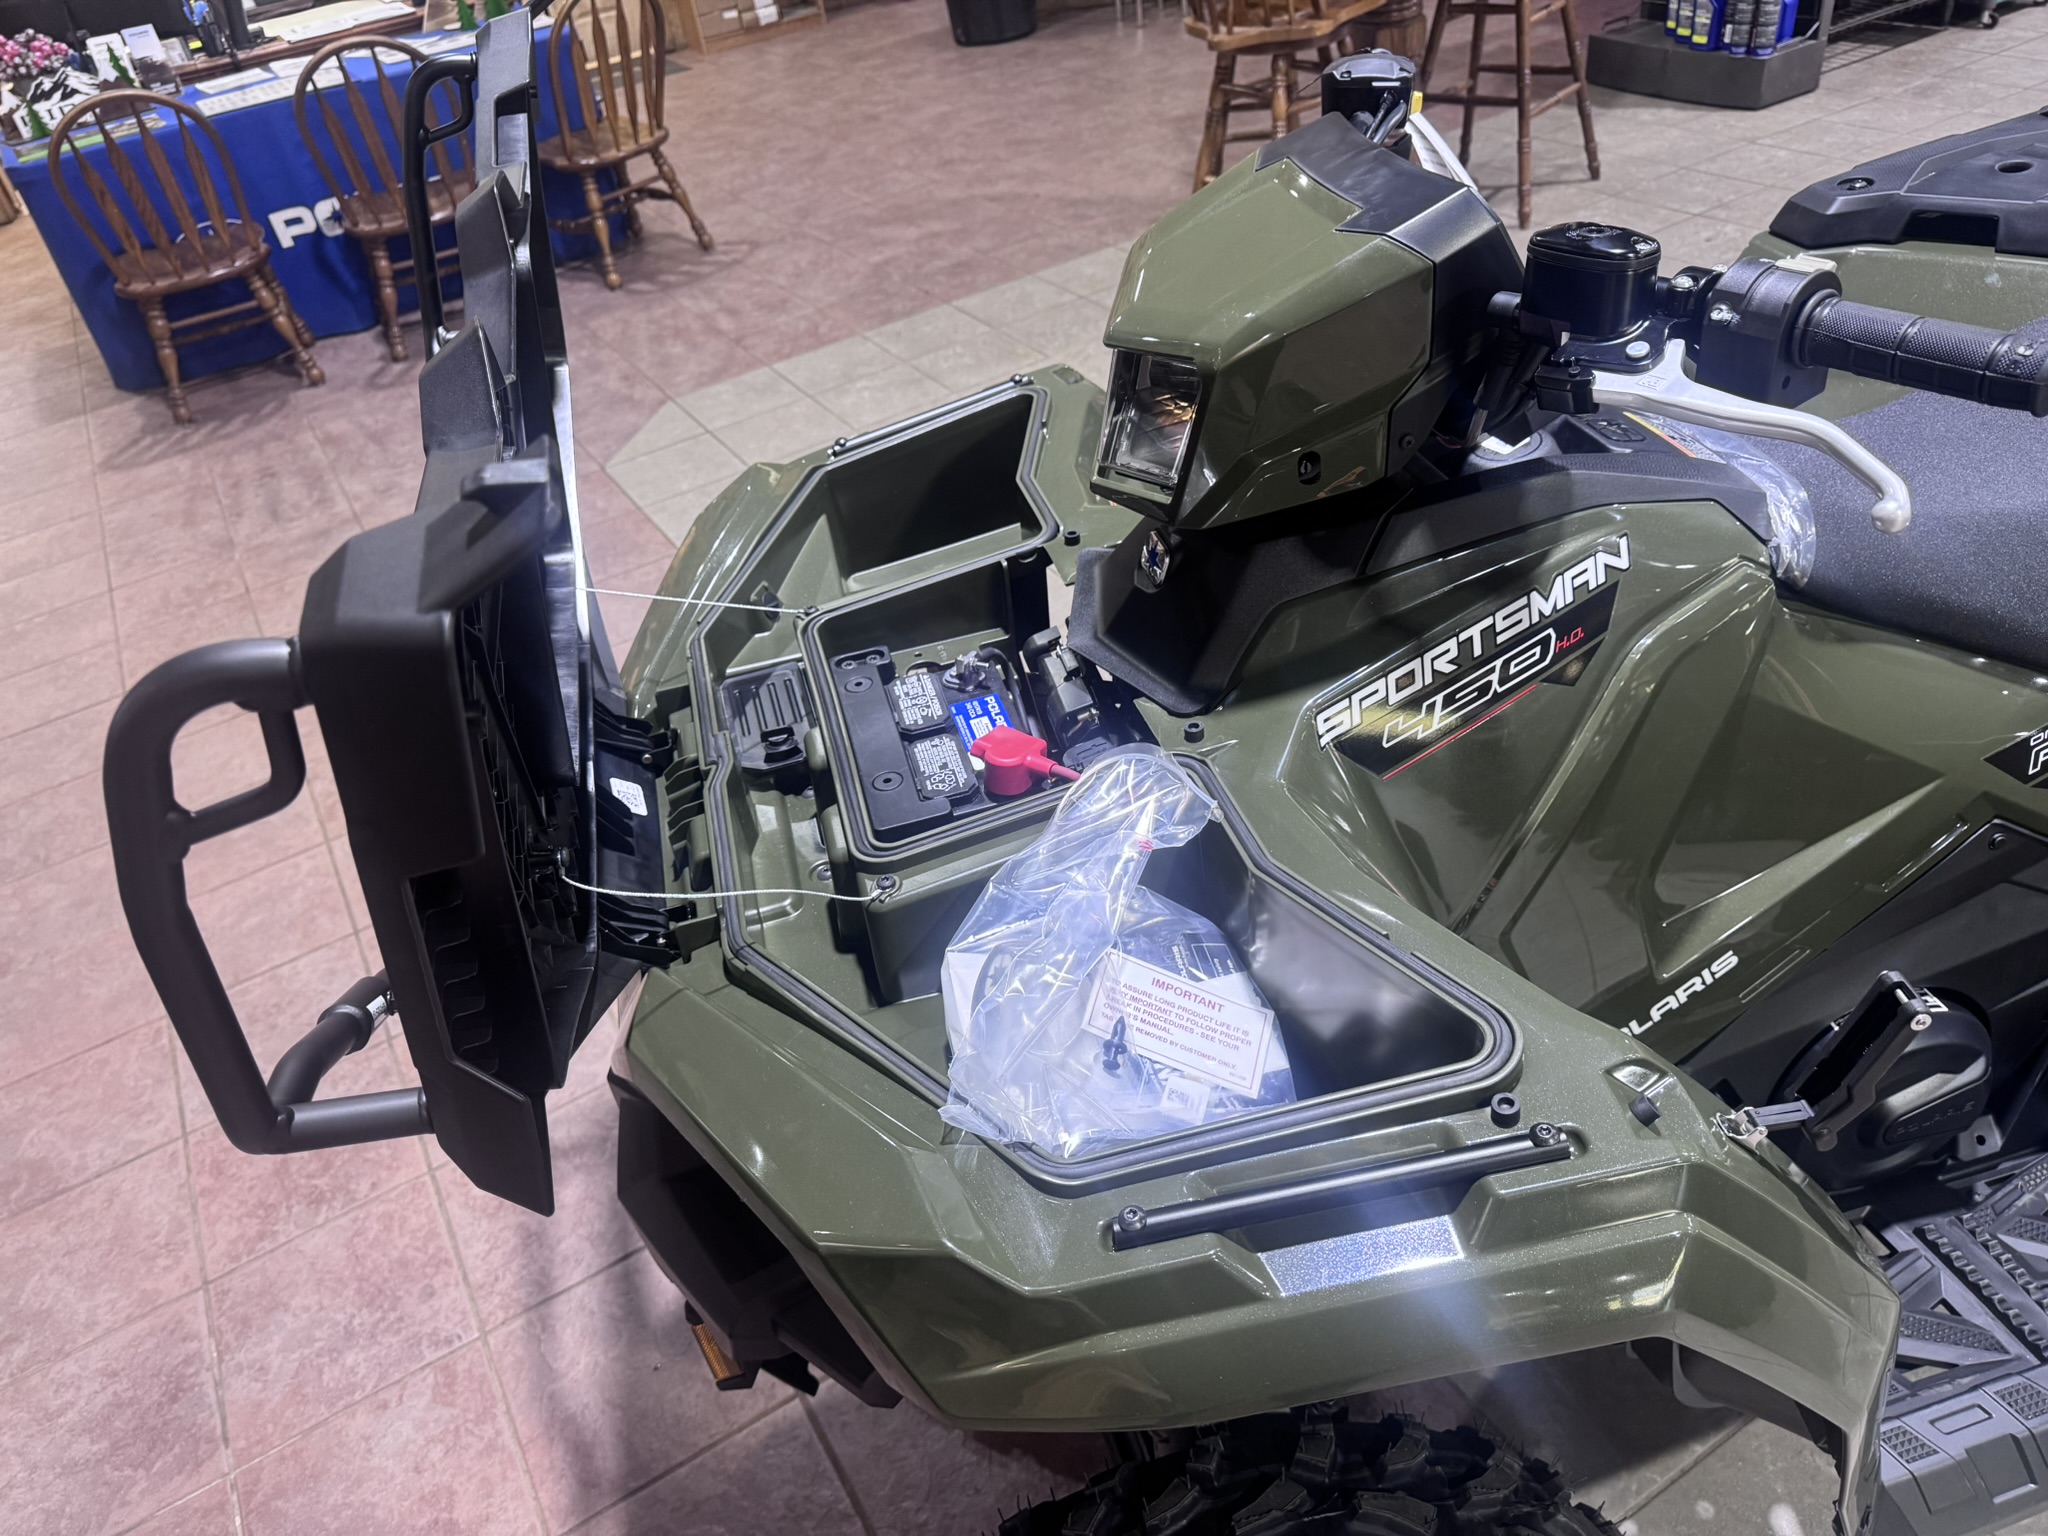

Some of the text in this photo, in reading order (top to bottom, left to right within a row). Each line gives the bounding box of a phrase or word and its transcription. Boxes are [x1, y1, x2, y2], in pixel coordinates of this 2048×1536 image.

[1315, 534, 1630, 748] SPORTSMAN
[1382, 627, 1585, 749] 450 H.O.
[984, 695, 1008, 728] POLA
[1172, 946, 1187, 980] OLARIS
[1123, 983, 1153, 999] ASSURE
[1154, 996, 1175, 1008] LONG
[1177, 1005, 1213, 1023] PRODUCT
[1215, 1020, 1231, 1030] LIFE
[1152, 978, 1224, 1012] IMPORTANT
[1620, 950, 1739, 1036] LARIS
[1129, 995, 1173, 1016] IMPORTANT
[1186, 1017, 1218, 1033] FOLLOW
[1220, 1031, 1251, 1046] PROPER
[1143, 1009, 1194, 1034] PROCEDURES
[1201, 1032, 1215, 1042] SEE
[1218, 1038, 1239, 1051] YOUR
[1136, 1027, 1168, 1043] REMOVED
[1180, 1044, 1216, 1061] CUSTOMER
